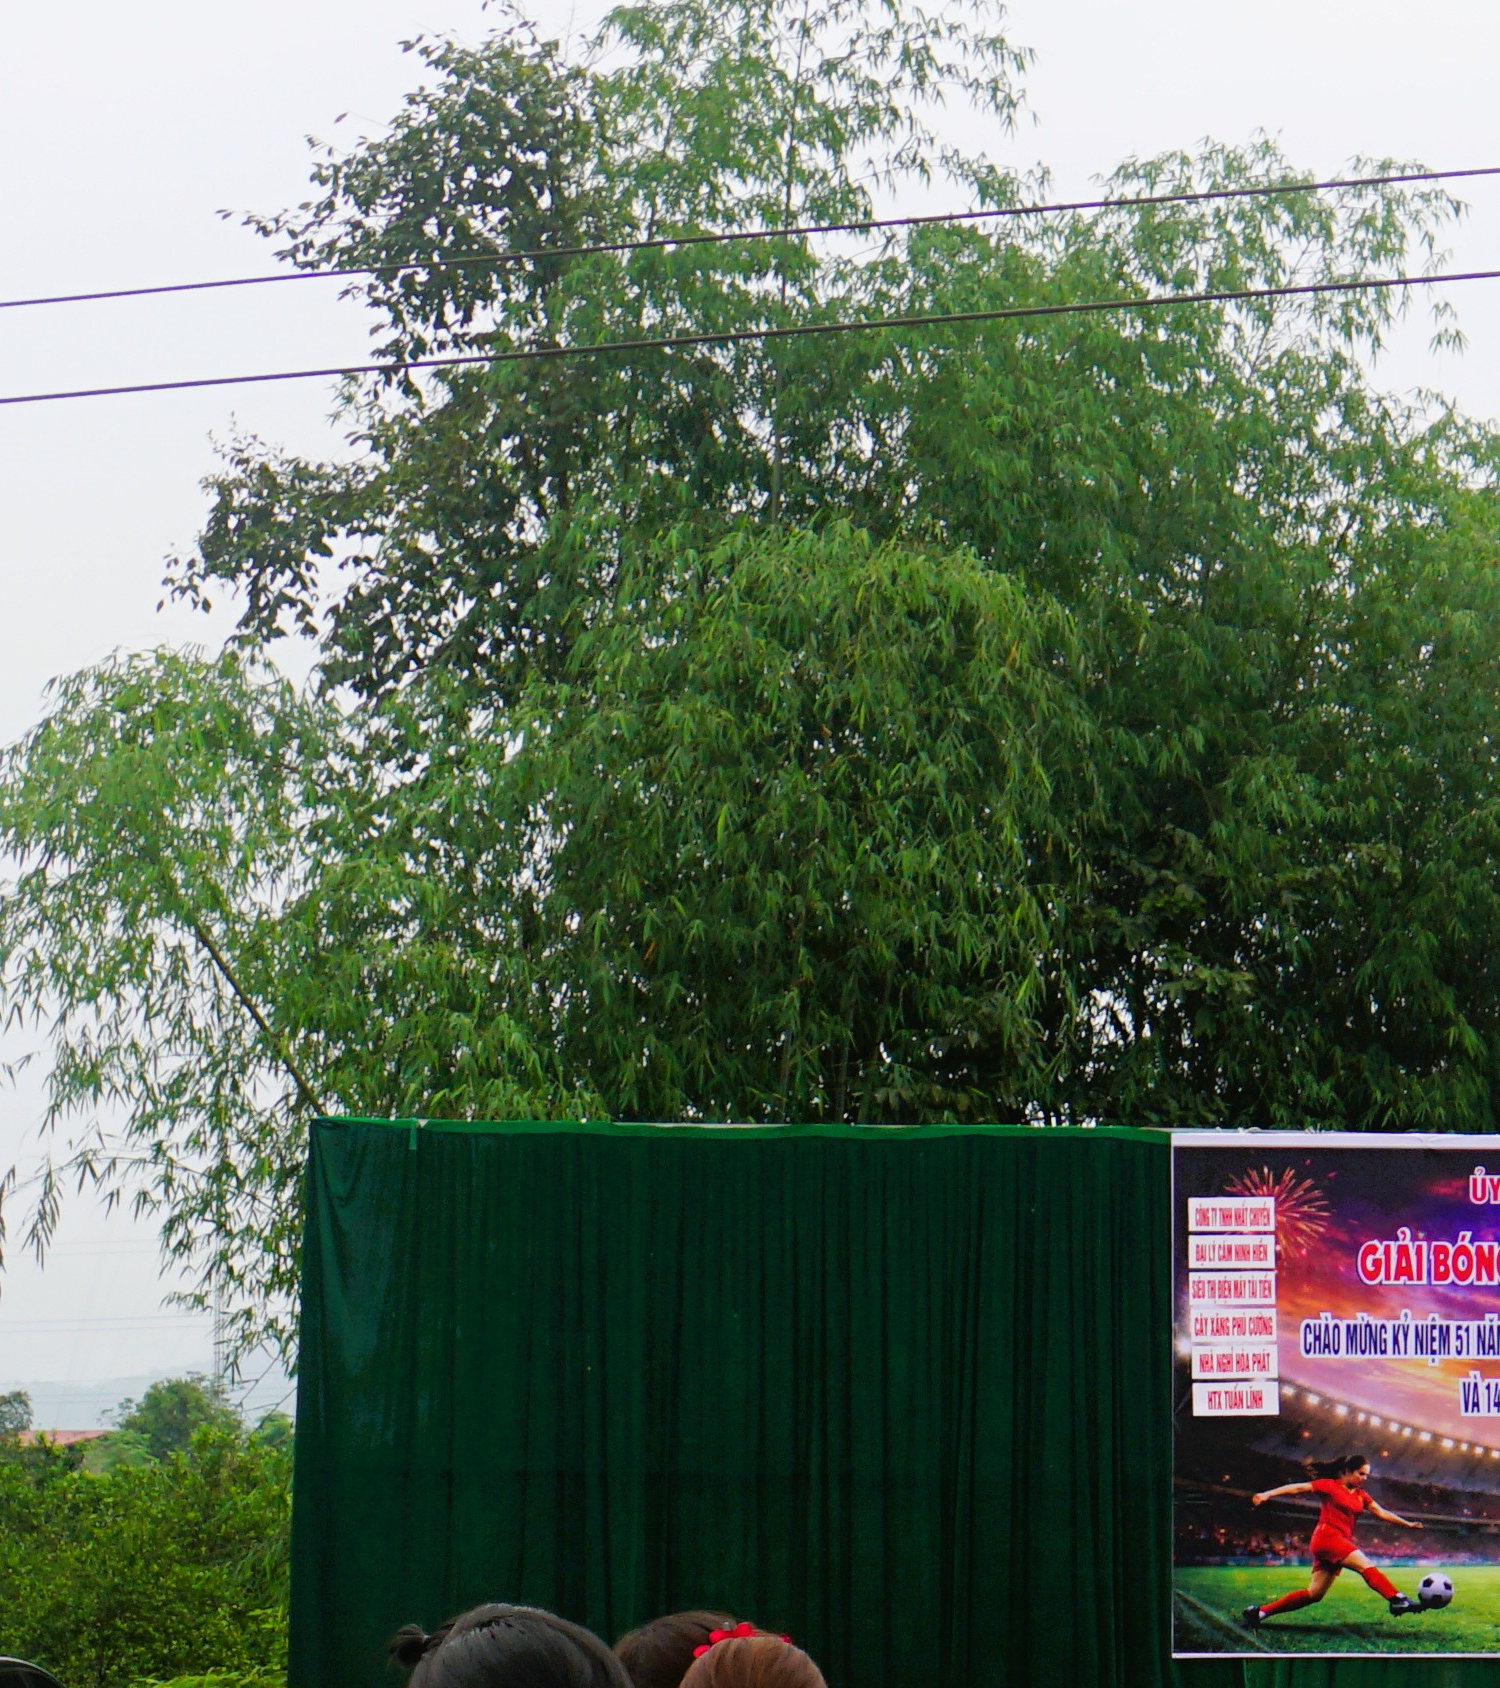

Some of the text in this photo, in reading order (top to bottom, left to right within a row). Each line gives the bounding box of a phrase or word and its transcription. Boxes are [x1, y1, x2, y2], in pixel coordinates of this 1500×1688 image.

[1357, 1227, 1428, 1286] GIẢI
[1302, 1313, 1341, 1358] CHÀO
[1345, 1313, 1388, 1358] MỪNG
[1392, 1310, 1411, 1358] KỶ
[1414, 1314, 1451, 1364] NIỆM
[1455, 1323, 1471, 1357] 51
[1208, 1390, 1222, 1409] HTX
[1462, 1372, 1481, 1414] VÀ
